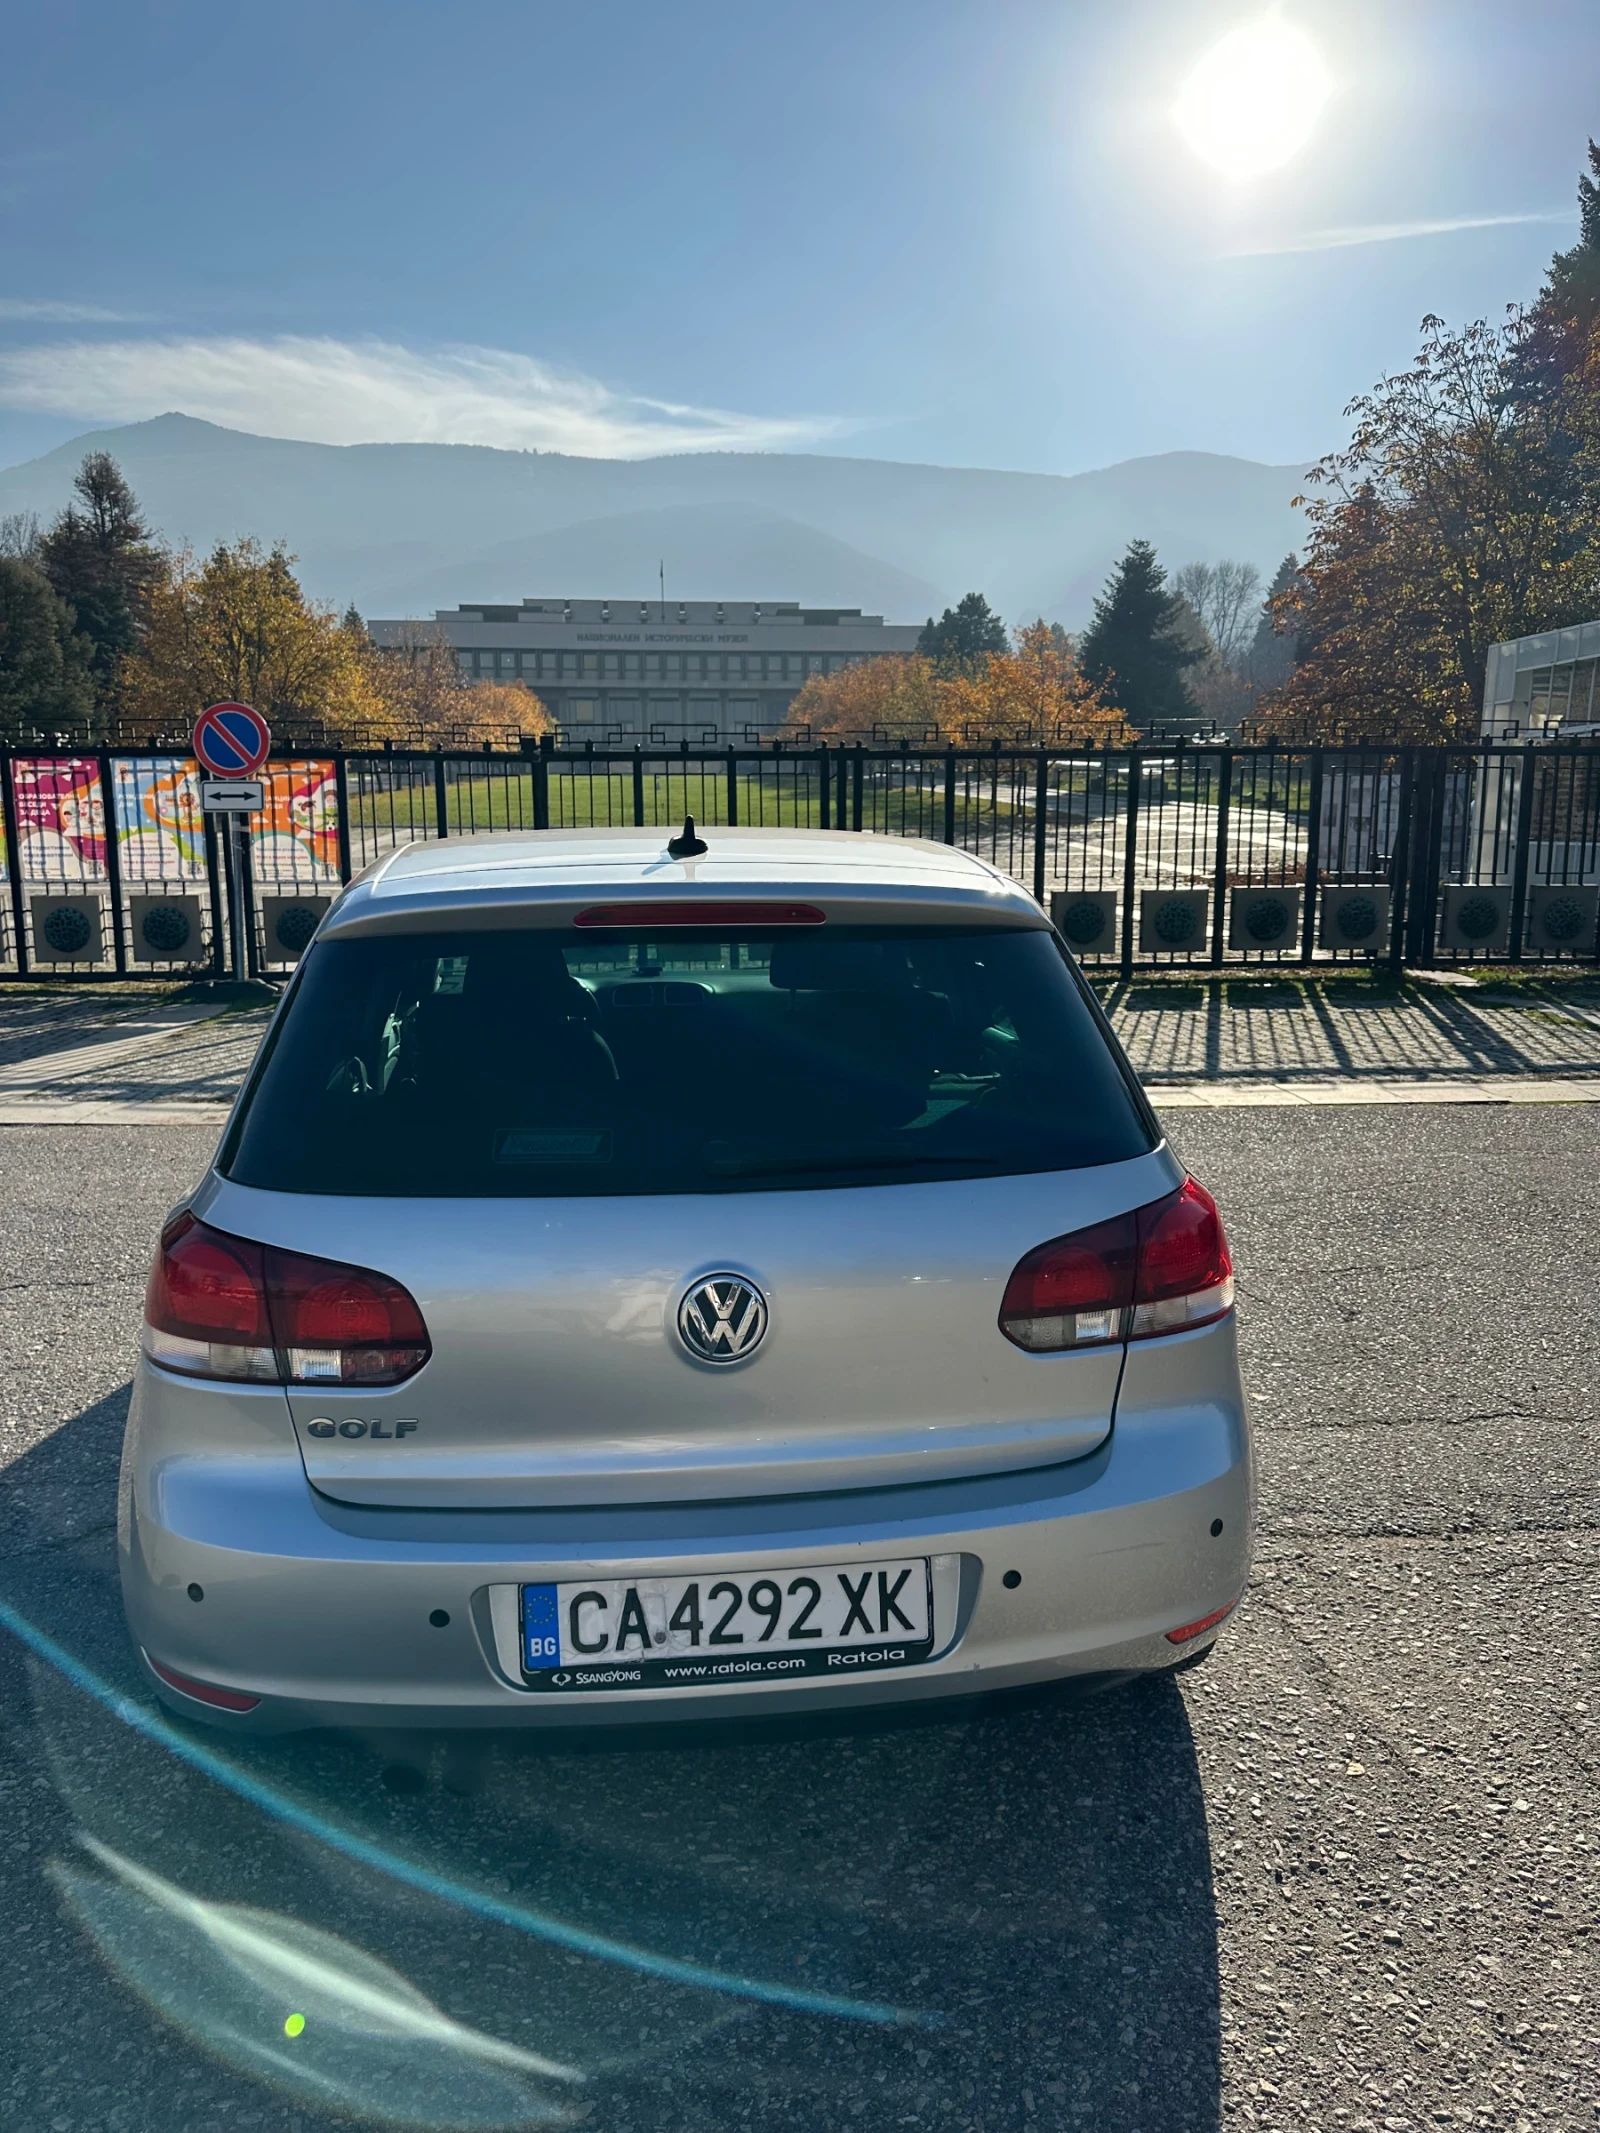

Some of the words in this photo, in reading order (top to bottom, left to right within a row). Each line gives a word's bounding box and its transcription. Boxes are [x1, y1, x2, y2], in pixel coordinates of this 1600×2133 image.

[307, 1416, 419, 1439] GOLF
[569, 1587, 652, 1654] CA
[669, 1576, 823, 1646] 4292
[837, 1569, 916, 1637] XK
[530, 1637, 557, 1657] BG
[664, 1657, 806, 1678] www.ratola.com
[827, 1649, 906, 1666] Ratola
